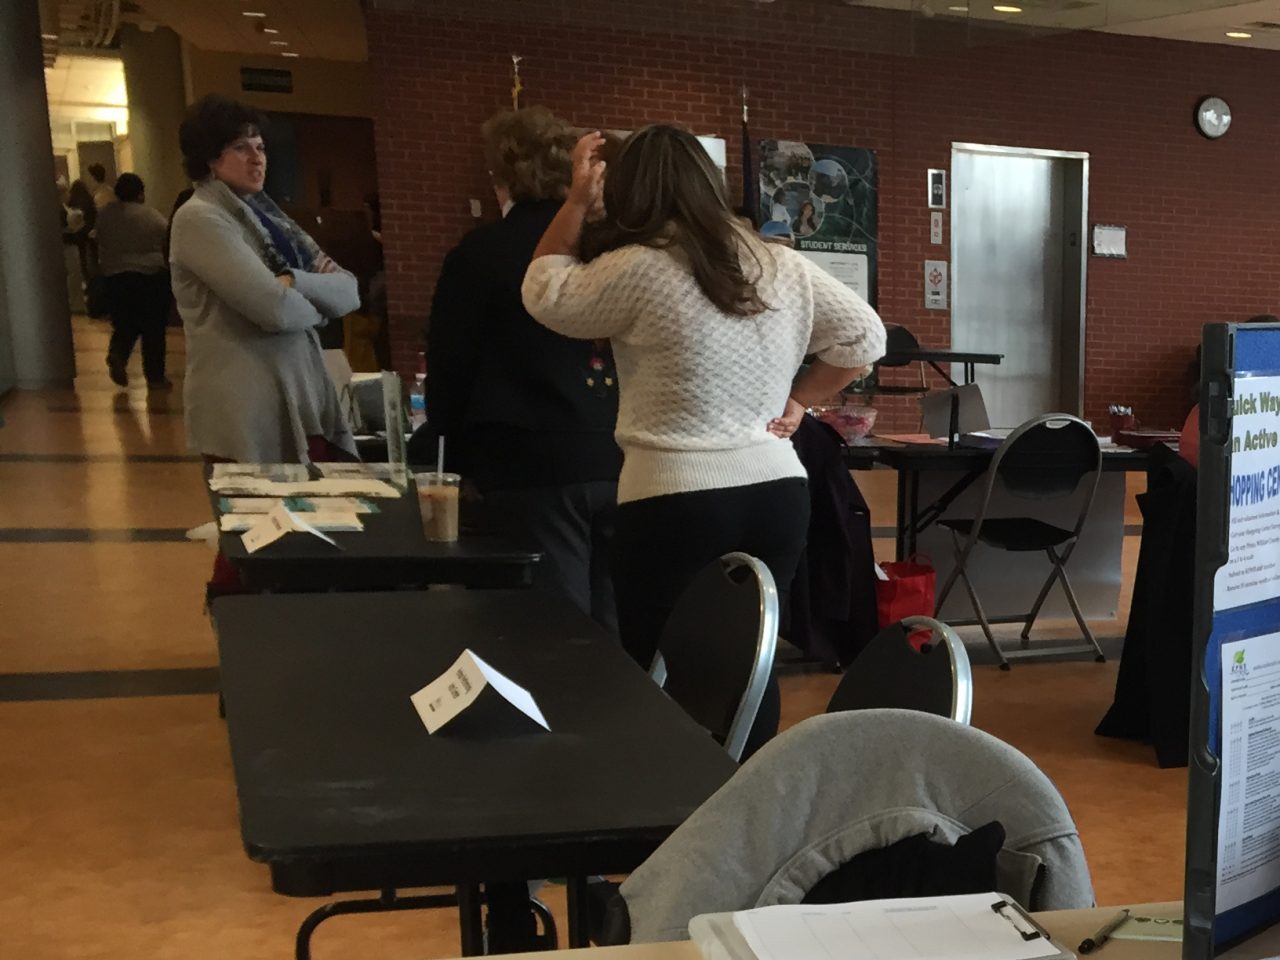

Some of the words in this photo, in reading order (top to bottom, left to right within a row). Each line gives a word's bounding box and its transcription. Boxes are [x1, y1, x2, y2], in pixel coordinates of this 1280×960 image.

[801, 241, 833, 250] STUDENT
[1232, 392, 1257, 416] uick
[1244, 428, 1278, 451] Active
